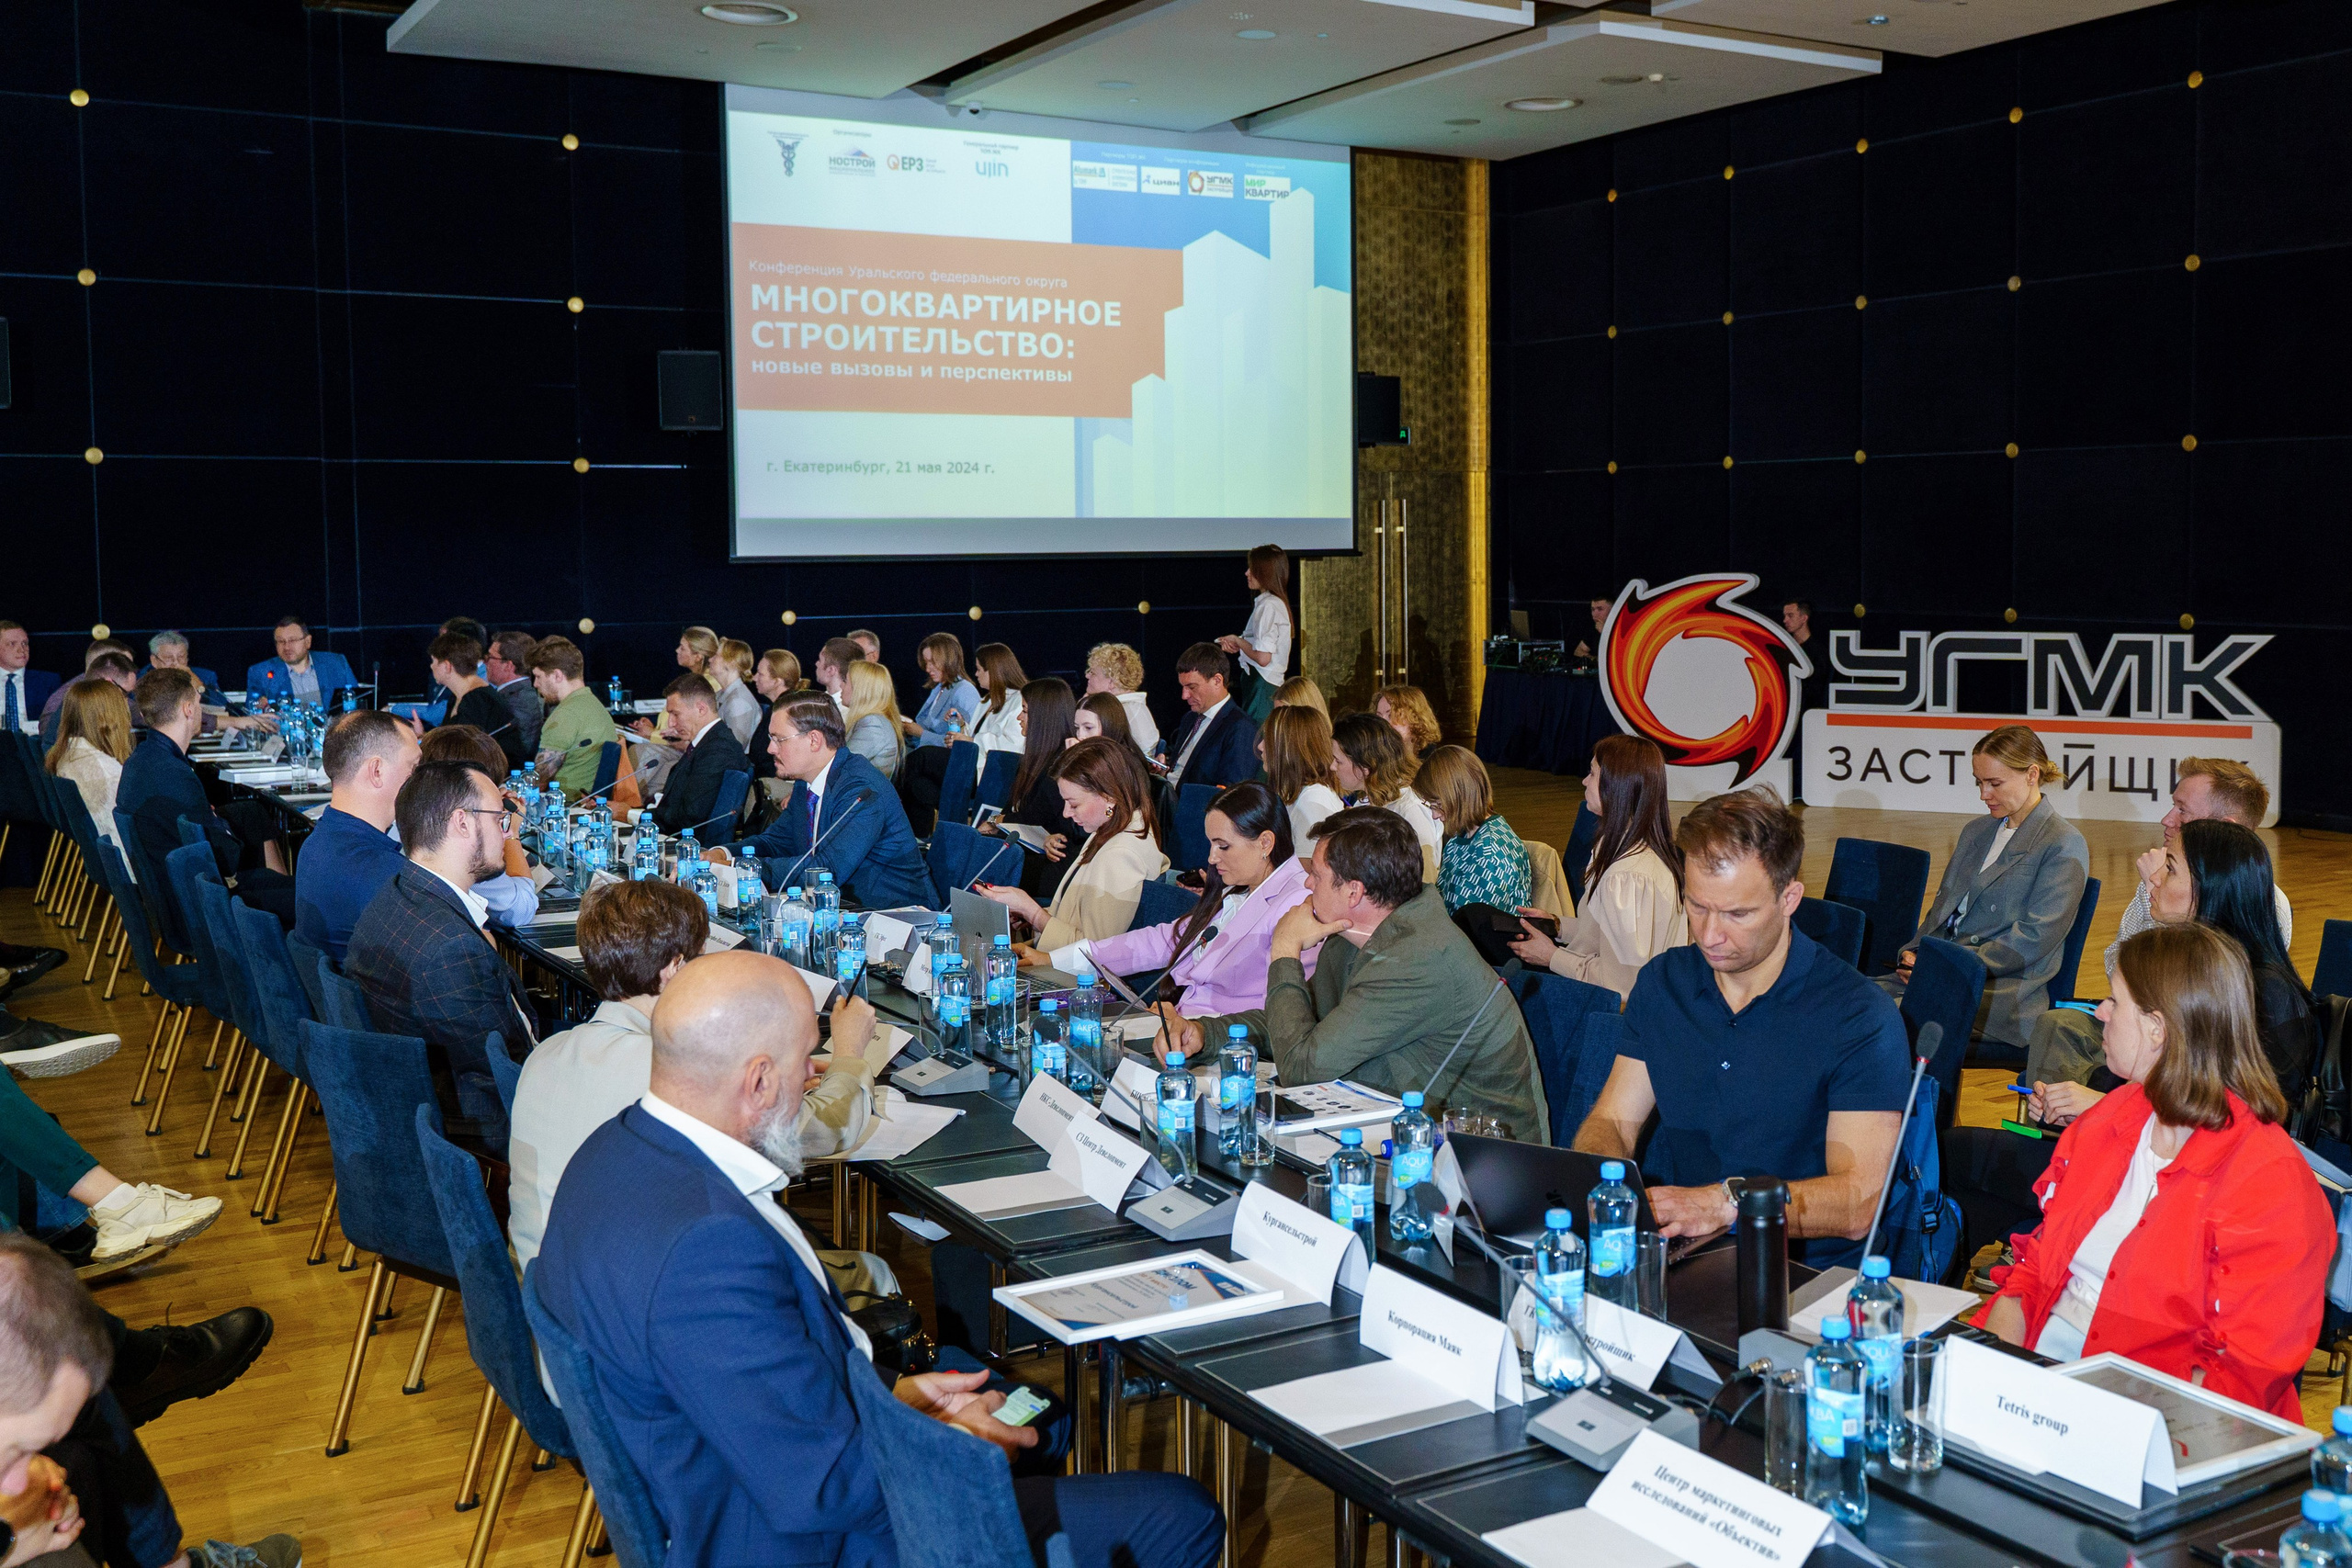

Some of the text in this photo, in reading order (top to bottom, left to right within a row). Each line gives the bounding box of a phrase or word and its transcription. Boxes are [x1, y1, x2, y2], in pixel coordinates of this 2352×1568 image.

[829, 156, 876, 168] НОСТРОЙ
[975, 158, 1009, 178] ujin
[1206, 175, 1233, 184] УГМК
[1245, 178, 1266, 187] МИР
[1245, 188, 1290, 198] КВАРТИР
[749, 260, 1068, 289] Конференция Уральского федерального округа
[751, 284, 1122, 327] МНОГОКВАРТИРНОЕ
[751, 321, 1076, 359] СТРОИТЕЛЬСТВО:
[752, 359, 1072, 384] новые вызовы и перспективы
[767, 460, 995, 476] г. Екатеринбург, 21 мая 2024 г.
[1828, 629, 2278, 723] УГМК
[1826, 742, 2249, 802] ЗАСТЙЩ
[1083, 1135, 1098, 1154] Центр
[1096, 1145, 1127, 1169] Девелопмент
[1401, 1155, 1430, 1168] AQUA
[1261, 1210, 1318, 1248] Кургансельстрой
[1387, 1310, 1463, 1357] Корпорация Маяк
[1996, 1394, 2069, 1437] Tetris group
[1654, 1464, 1782, 1537] Центр маркетинговых
[1631, 1480, 1782, 1562] исследований «Объектив»
